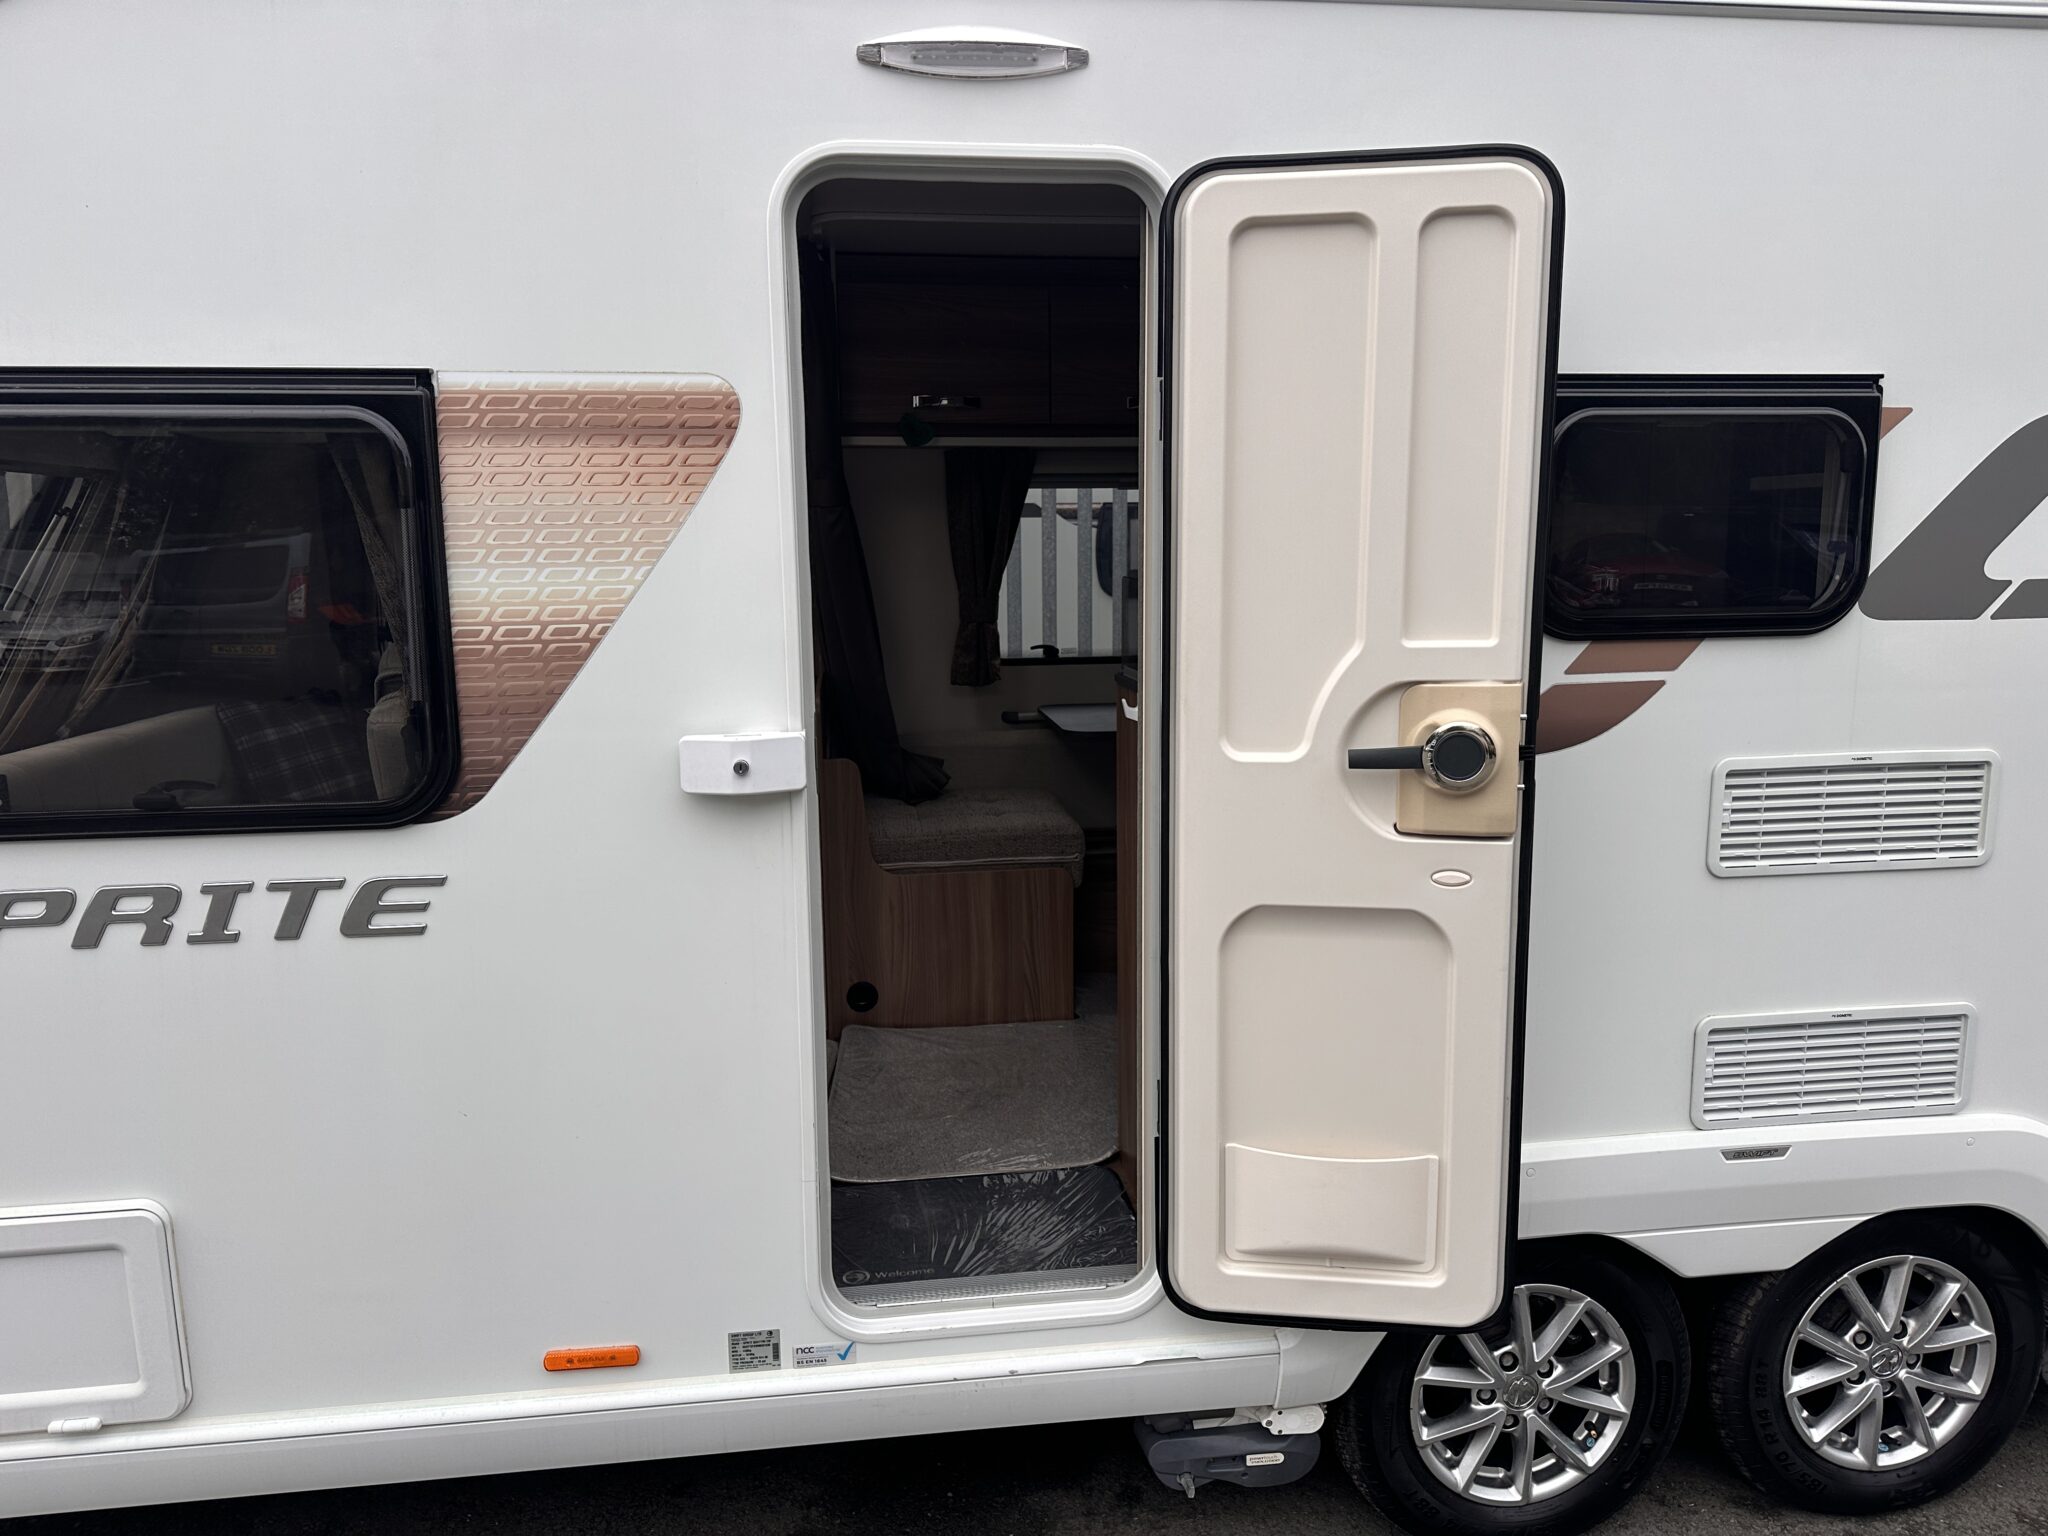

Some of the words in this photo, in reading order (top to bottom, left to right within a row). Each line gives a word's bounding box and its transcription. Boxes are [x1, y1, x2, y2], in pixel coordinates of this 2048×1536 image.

[0, 874, 448, 949] PRITE
[875, 1268, 934, 1278] Welcome
[796, 1346, 815, 1354] ncc
